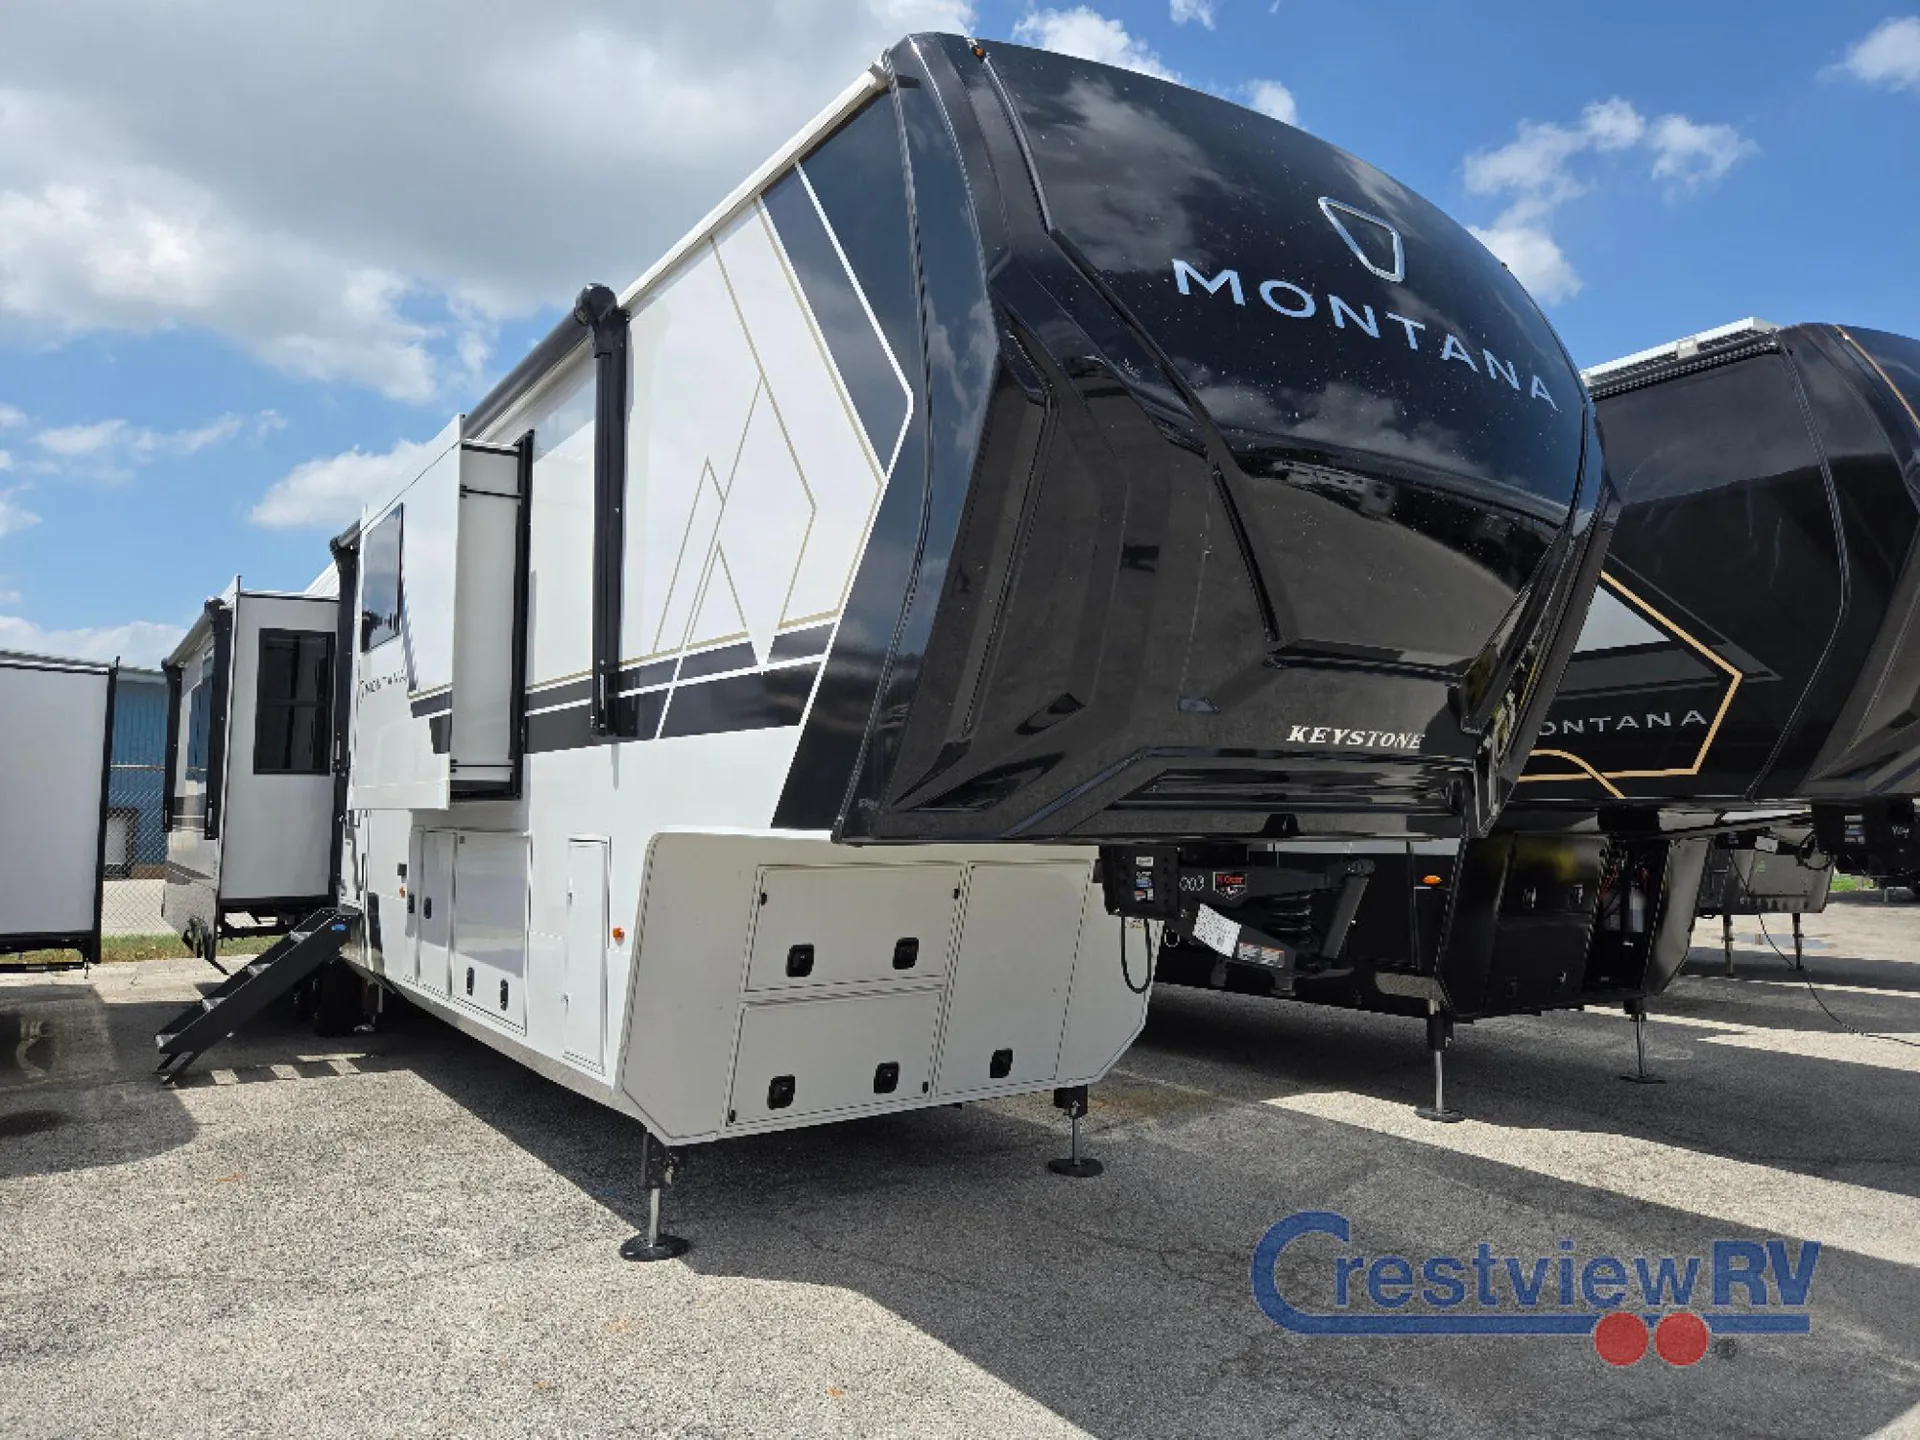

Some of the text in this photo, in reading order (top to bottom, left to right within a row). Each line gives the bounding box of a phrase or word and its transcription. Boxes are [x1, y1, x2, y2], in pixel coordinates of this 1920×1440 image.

[1172, 258, 1559, 412] MONTANA
[1538, 709, 1707, 736] ONTANA
[1286, 724, 1425, 749] KEYSTONE
